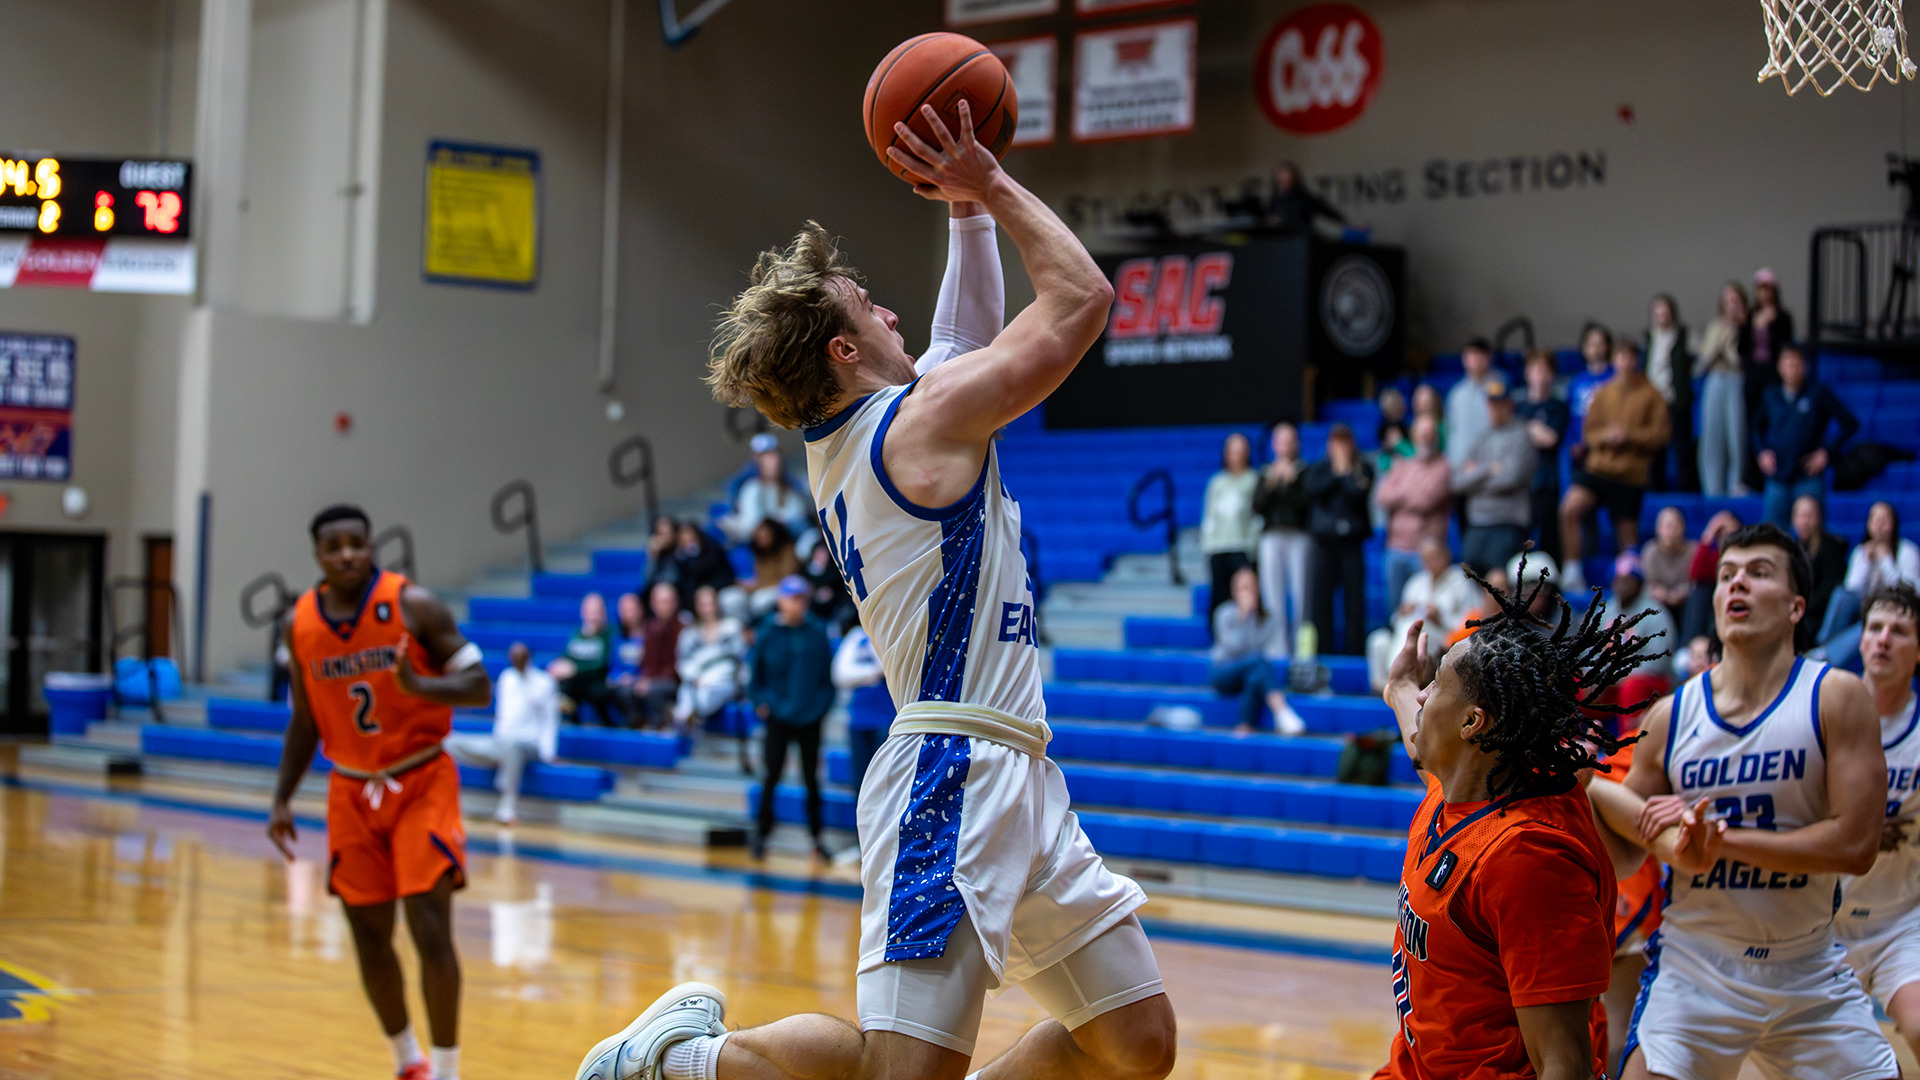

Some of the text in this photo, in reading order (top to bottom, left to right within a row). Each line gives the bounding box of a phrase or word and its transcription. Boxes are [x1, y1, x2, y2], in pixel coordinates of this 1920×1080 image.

[119, 160, 186, 189] GUEST
[1423, 152, 1605, 200] SECTION
[135, 189, 183, 234] 72
[1106, 252, 1235, 338] SAC
[347, 680, 382, 736] 2
[1681, 750, 1806, 789] GOLDEN
